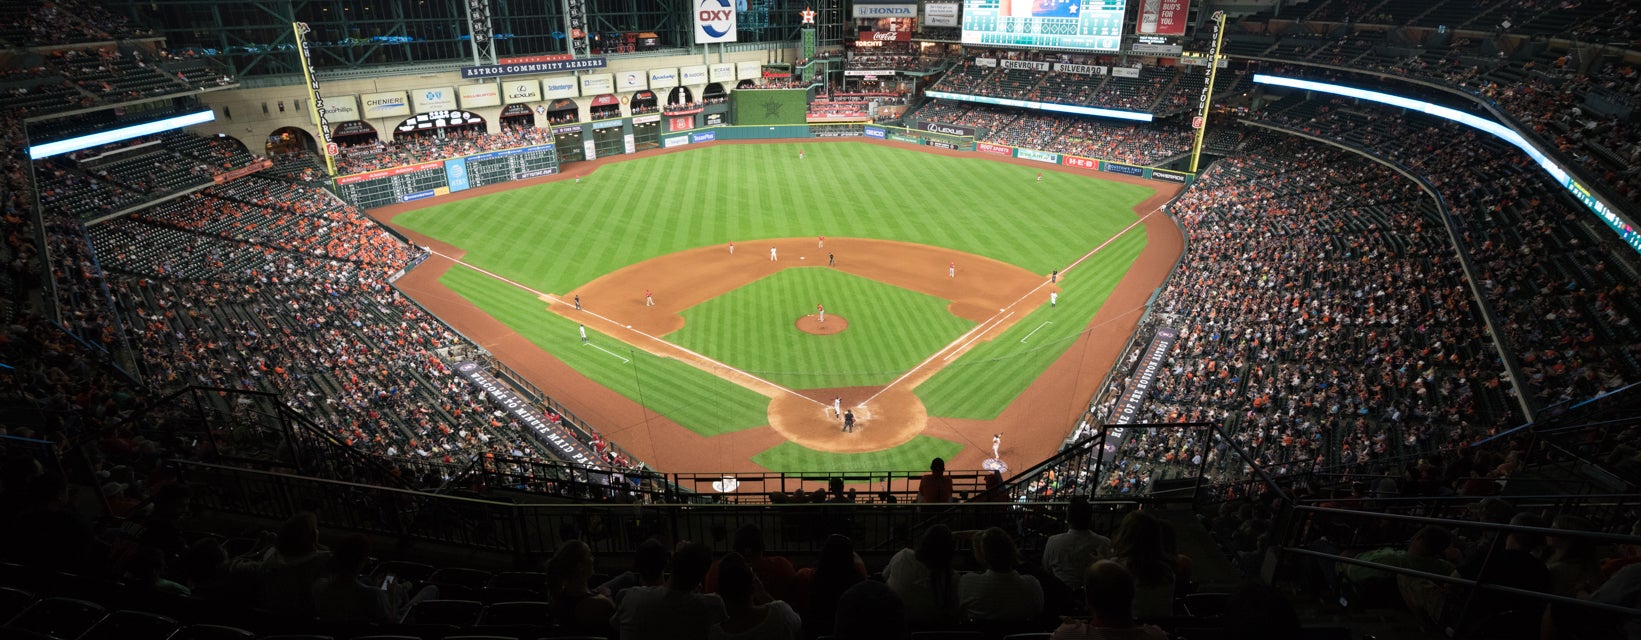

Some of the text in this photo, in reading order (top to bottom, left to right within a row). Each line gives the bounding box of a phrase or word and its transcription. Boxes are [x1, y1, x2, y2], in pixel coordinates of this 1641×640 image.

[1162, 3, 1181, 11] BUD'S
[699, 10, 732, 21] OXY
[1161, 10, 1173, 18] FOR
[1204, 25, 1218, 76] BURGERZ
[467, 59, 603, 76] ASTROS COMMUNITY LEADERS
[1004, 60, 1045, 70] CHEVROLET
[1059, 64, 1101, 74] SILVERADO
[1204, 77, 1210, 85] R
[302, 41, 332, 142] CHIKIN IZ FARE
[366, 97, 404, 107] CHENIERE
[1197, 87, 1208, 116] FOUL
[865, 129, 884, 137] GEICO
[937, 127, 964, 136] LEXUS
[1152, 340, 1169, 362] ASTROS
[1137, 360, 1158, 389] HOUSTON
[1129, 389, 1144, 403] THE
[470, 372, 508, 400] WELCOME
[504, 398, 518, 409] TO
[514, 404, 551, 434] MINUTE
[547, 432, 575, 453] MAID
[1123, 403, 1136, 414] OF
